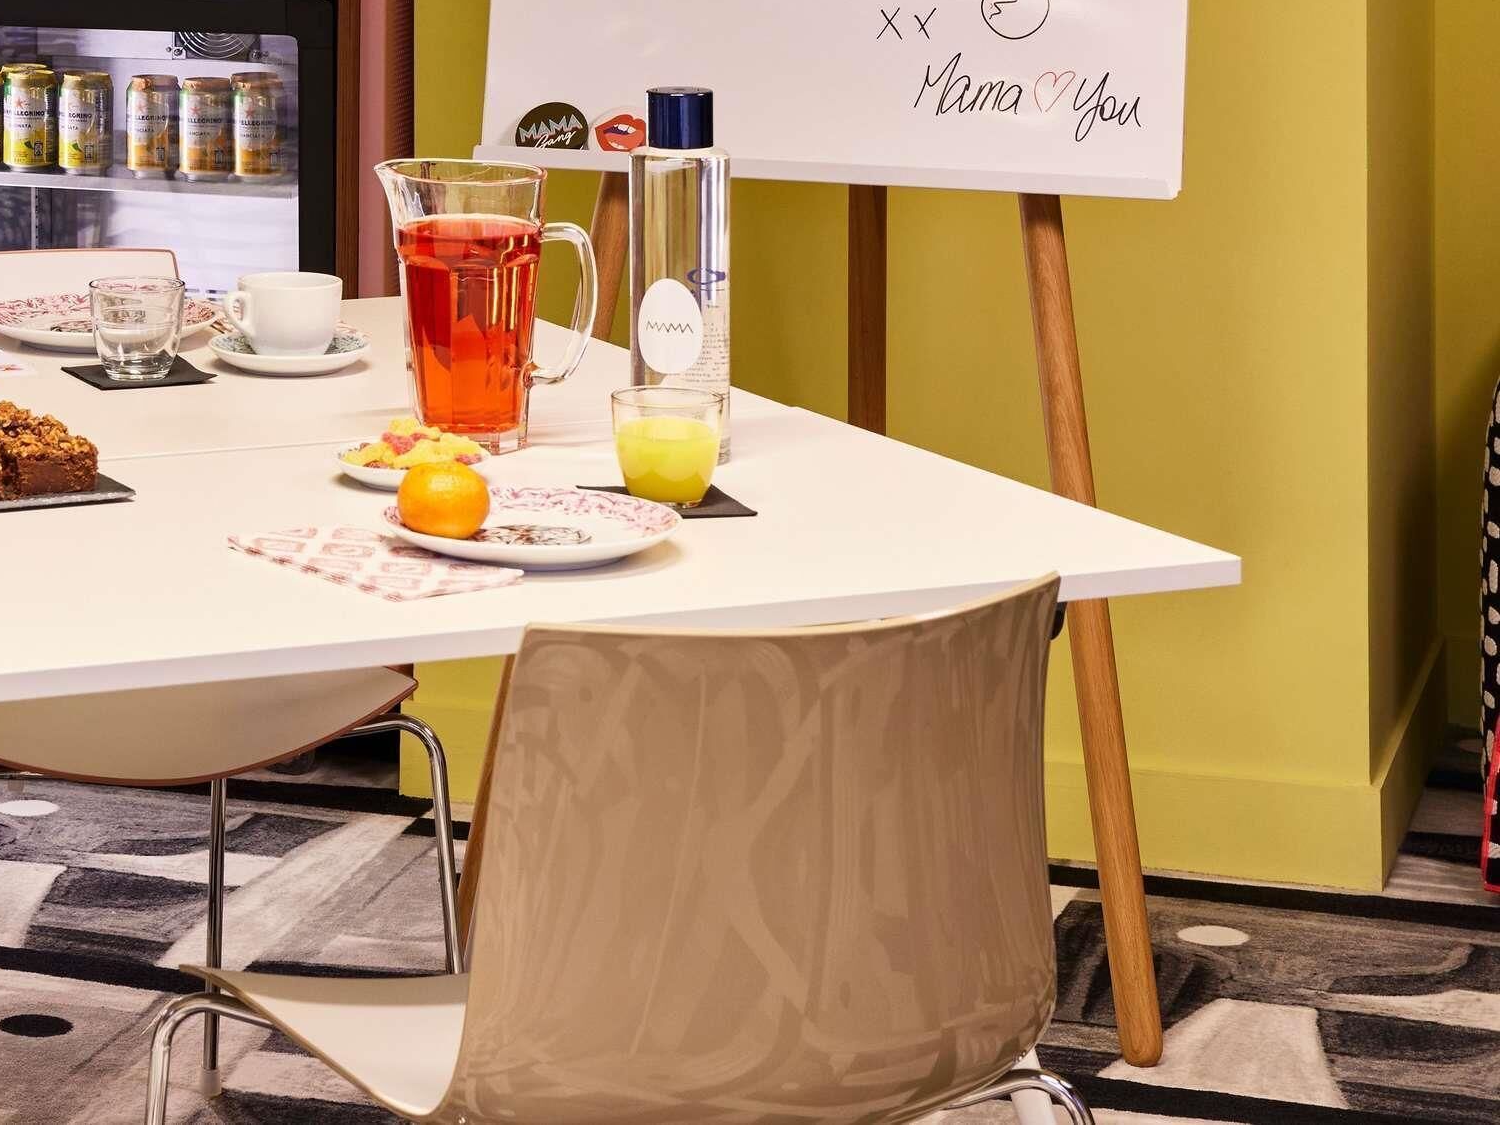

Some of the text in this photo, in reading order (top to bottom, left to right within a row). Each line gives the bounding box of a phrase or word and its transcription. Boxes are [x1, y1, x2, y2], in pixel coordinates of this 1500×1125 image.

[913, 52, 1142, 142] Mama You
[519, 113, 583, 143] MAMA
[646, 320, 694, 333] MAMA
